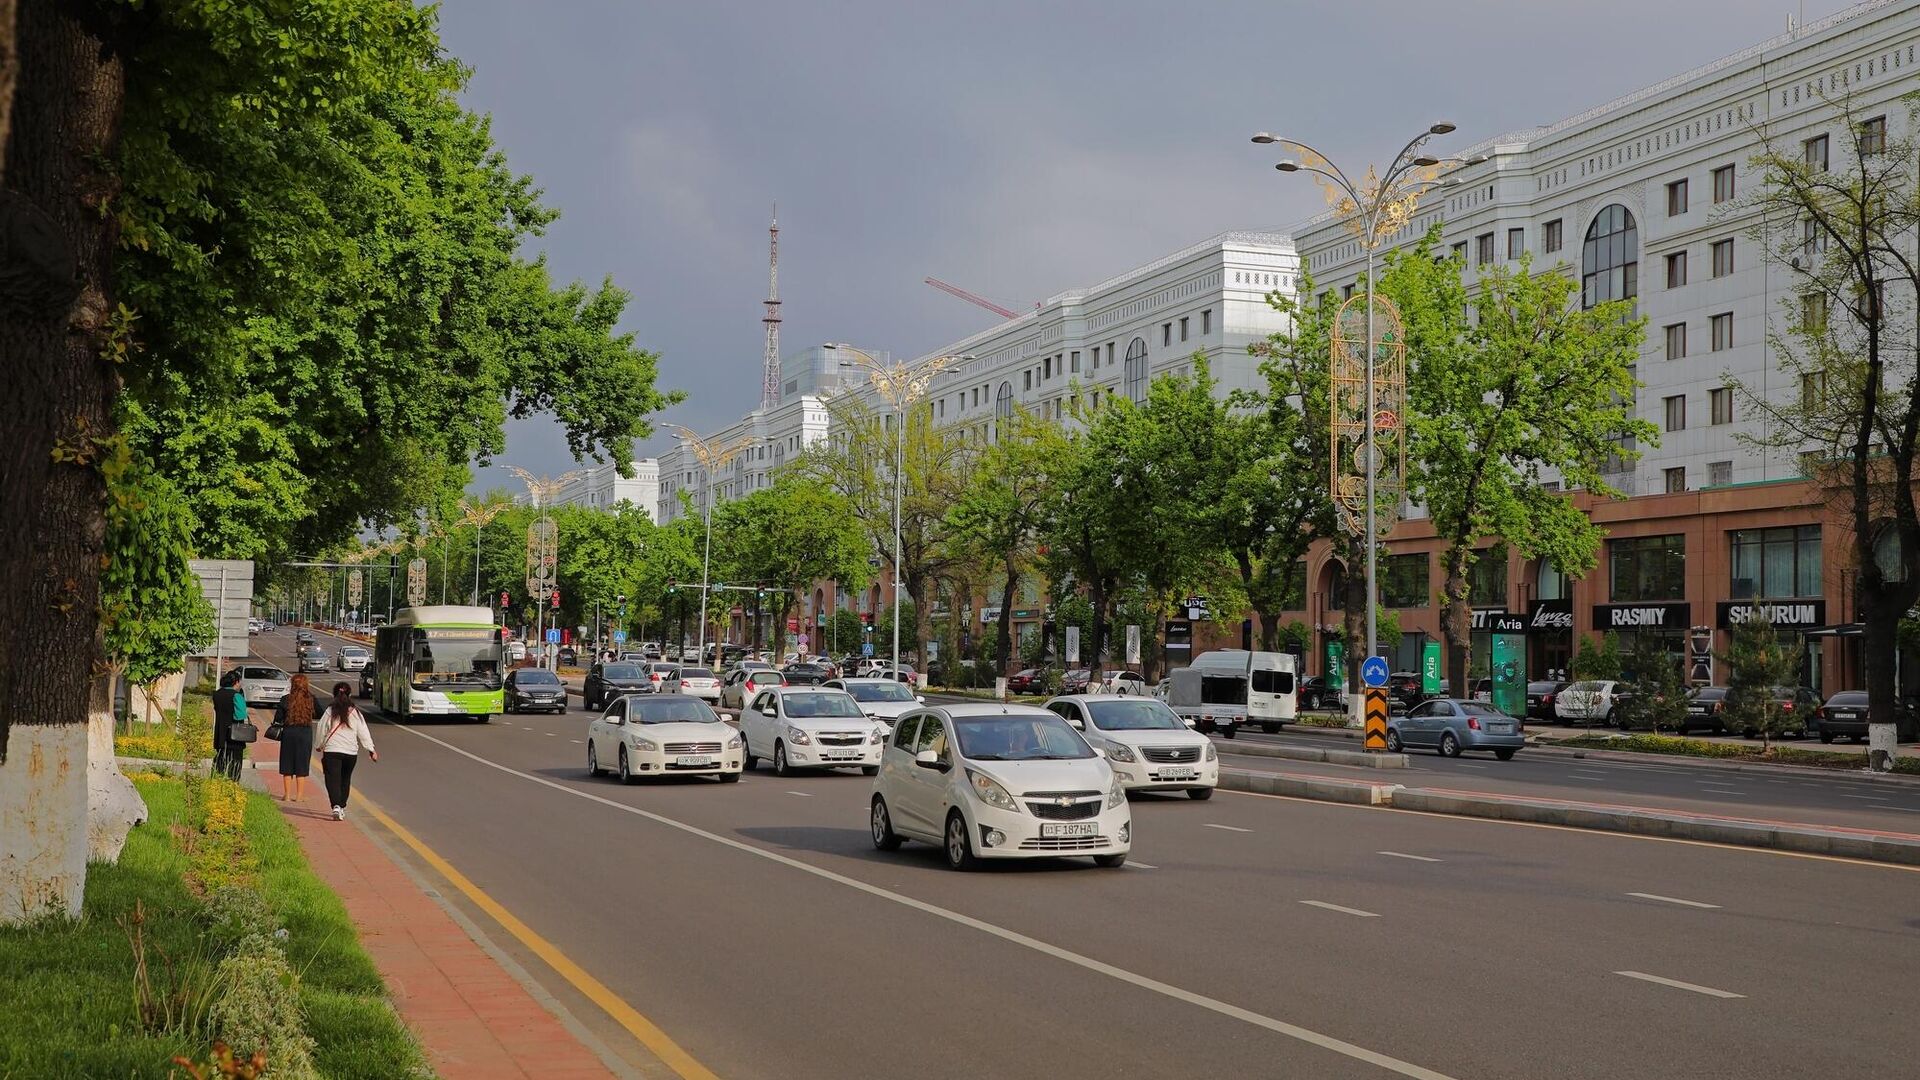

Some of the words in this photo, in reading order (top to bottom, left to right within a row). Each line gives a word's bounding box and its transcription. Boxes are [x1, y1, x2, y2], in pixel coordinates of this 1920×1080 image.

[1497, 618, 1522, 630] Aria
[1611, 607, 1666, 625] RASMIY
[1329, 655, 1337, 676] Aria
[1427, 656, 1435, 679] Aria
